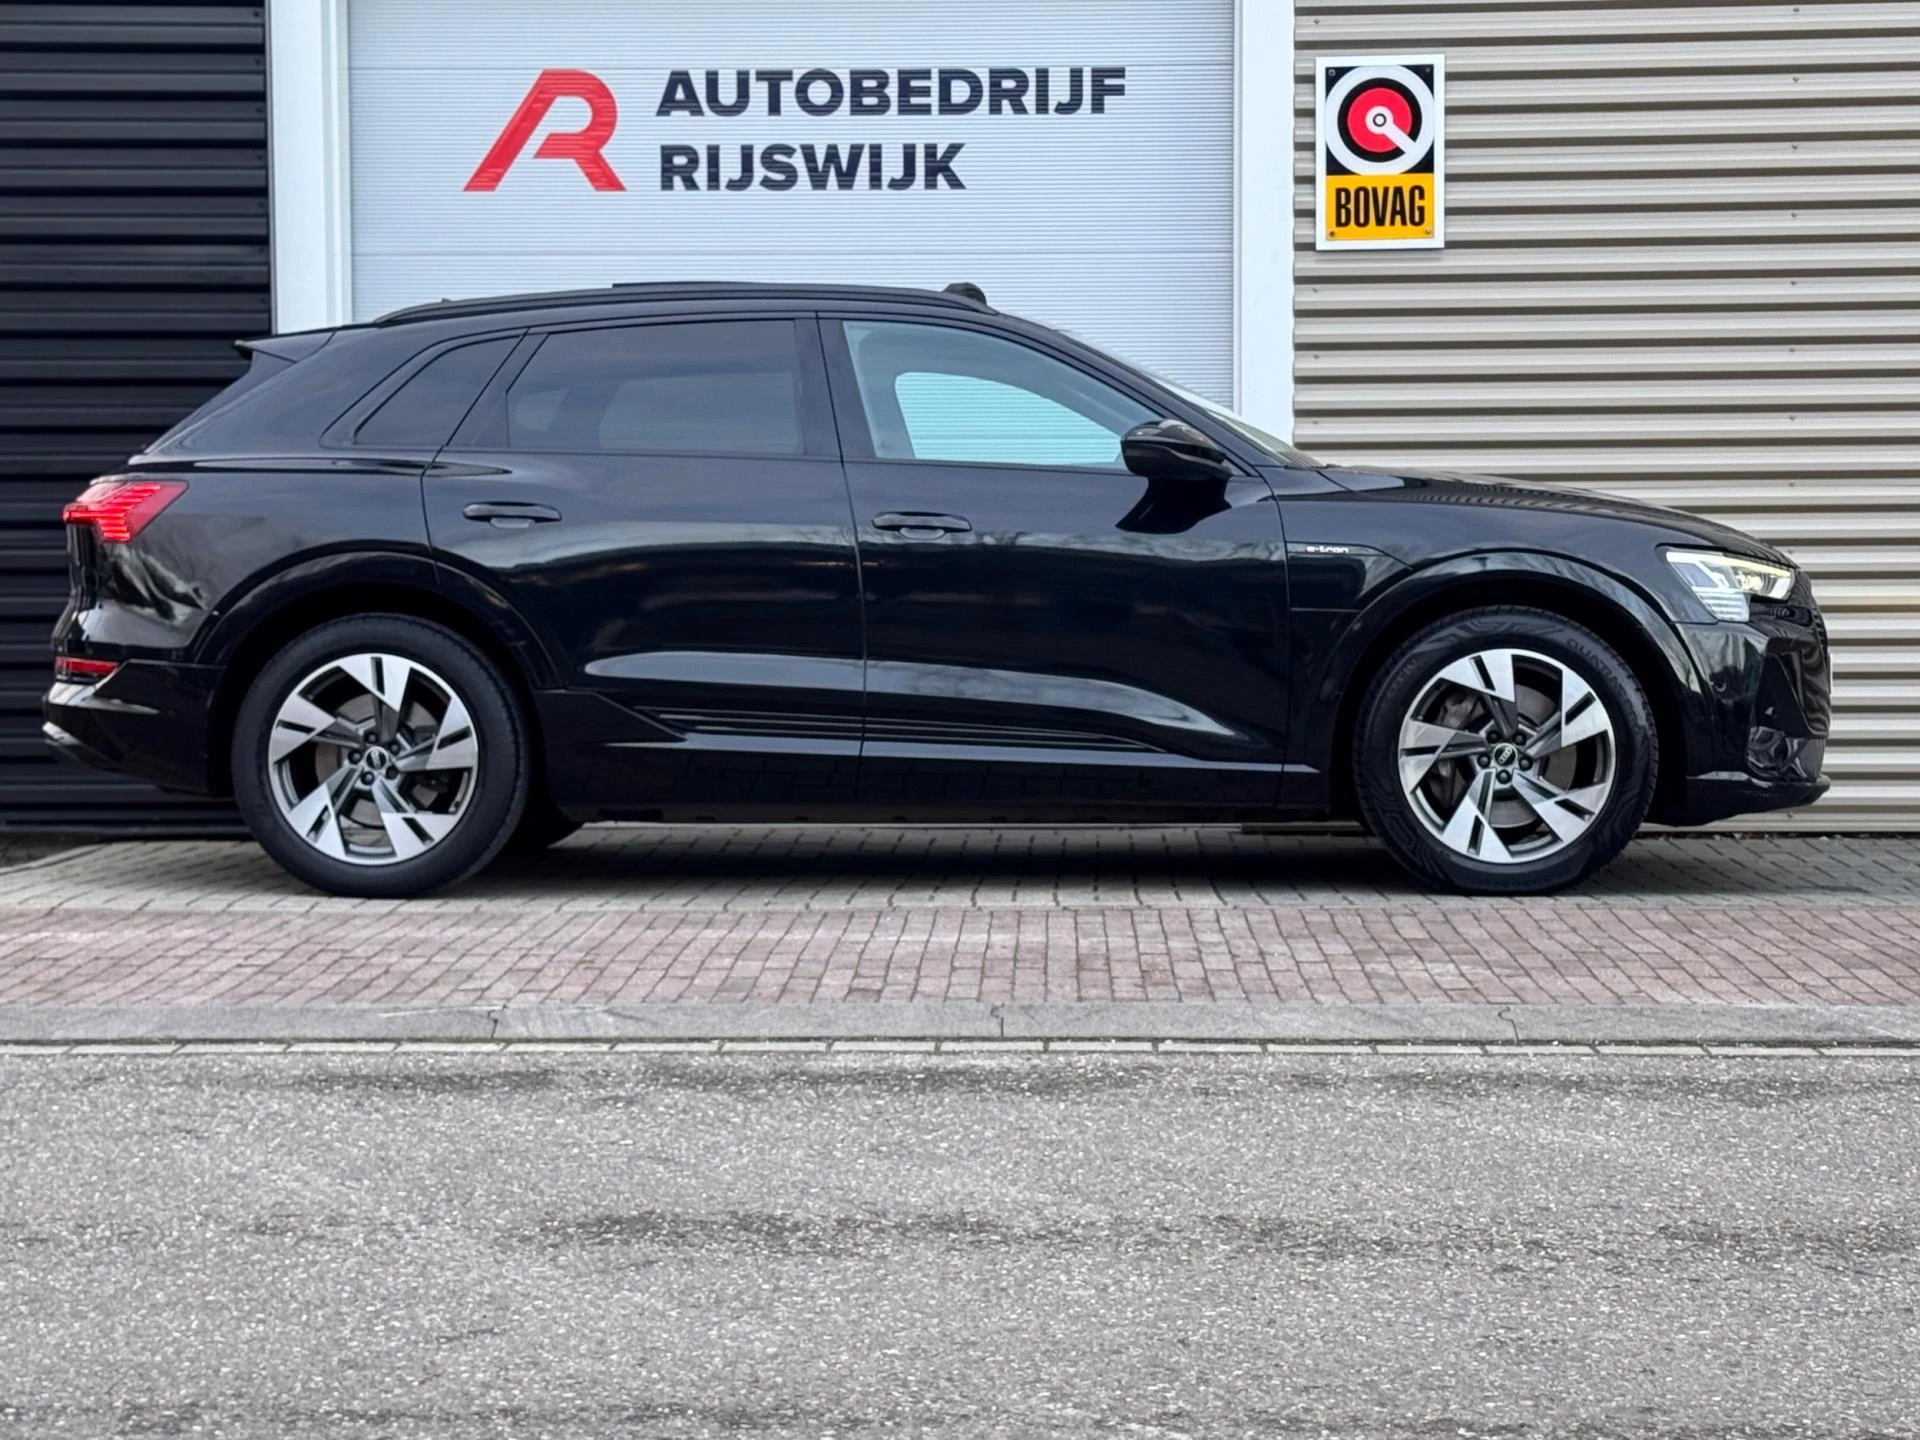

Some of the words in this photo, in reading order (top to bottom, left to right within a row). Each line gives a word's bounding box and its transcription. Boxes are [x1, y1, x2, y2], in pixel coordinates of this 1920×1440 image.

[655, 66, 1126, 117] AUTOBEDRIJF
[660, 143, 967, 191] RIJSWIJK
[1335, 185, 1425, 228] BOVAG
[1306, 545, 1349, 553] e-tron
